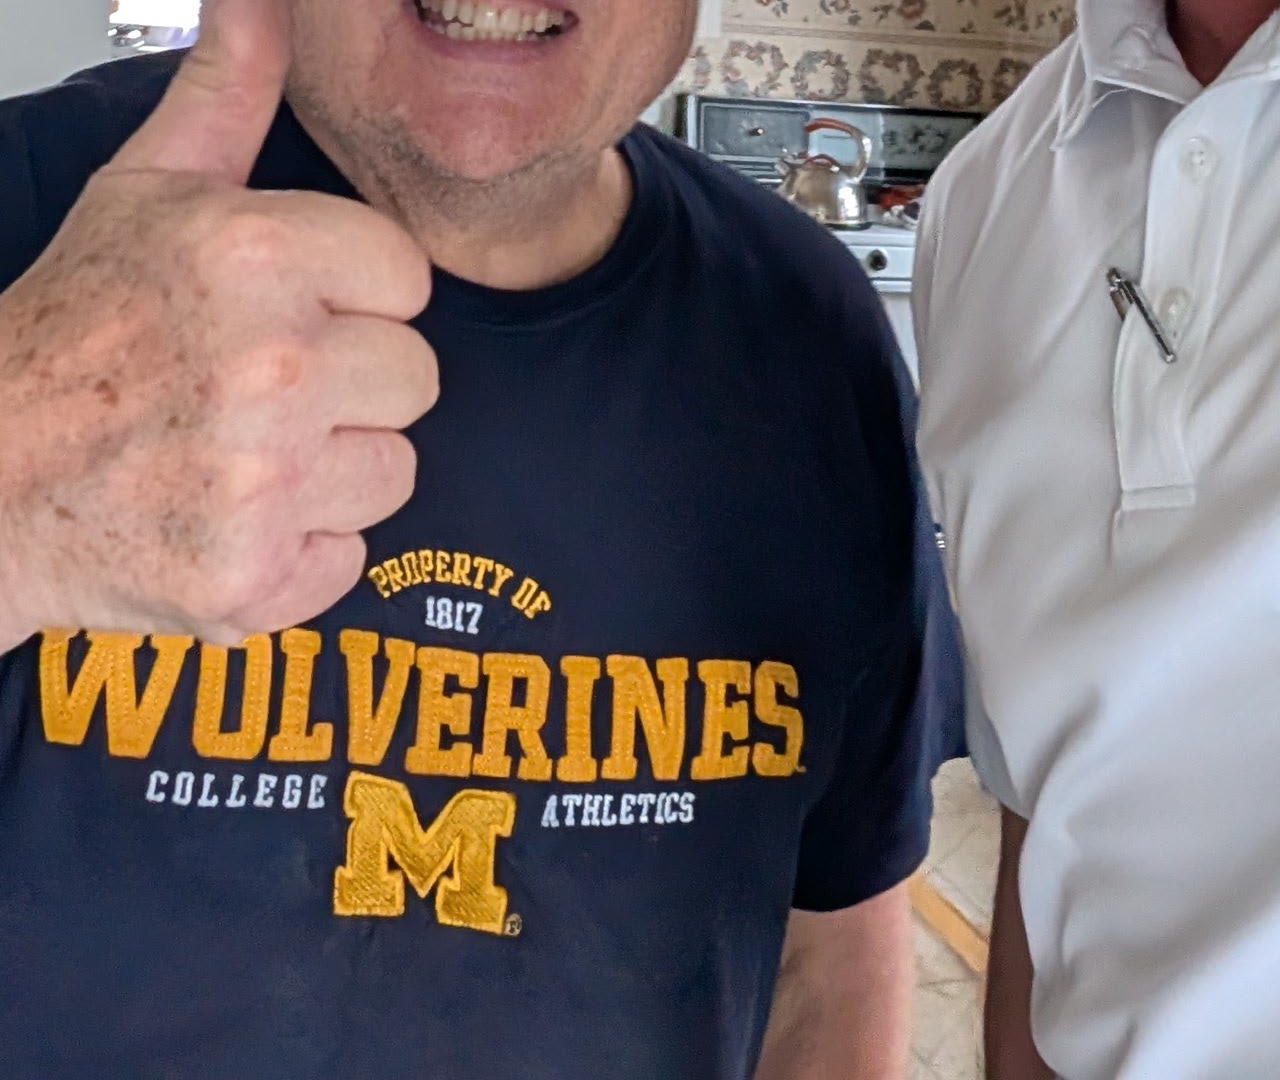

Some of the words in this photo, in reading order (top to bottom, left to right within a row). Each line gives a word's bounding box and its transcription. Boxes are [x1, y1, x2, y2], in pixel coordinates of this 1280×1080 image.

[367, 548, 514, 599] PROPERTY
[511, 576, 552, 620] OF
[425, 595, 484, 635] 1817
[39, 626, 804, 783] WOLVERINES
[145, 770, 328, 809] COLLEGE
[540, 792, 696, 828] ATHLETICS
[333, 770, 517, 936] M
